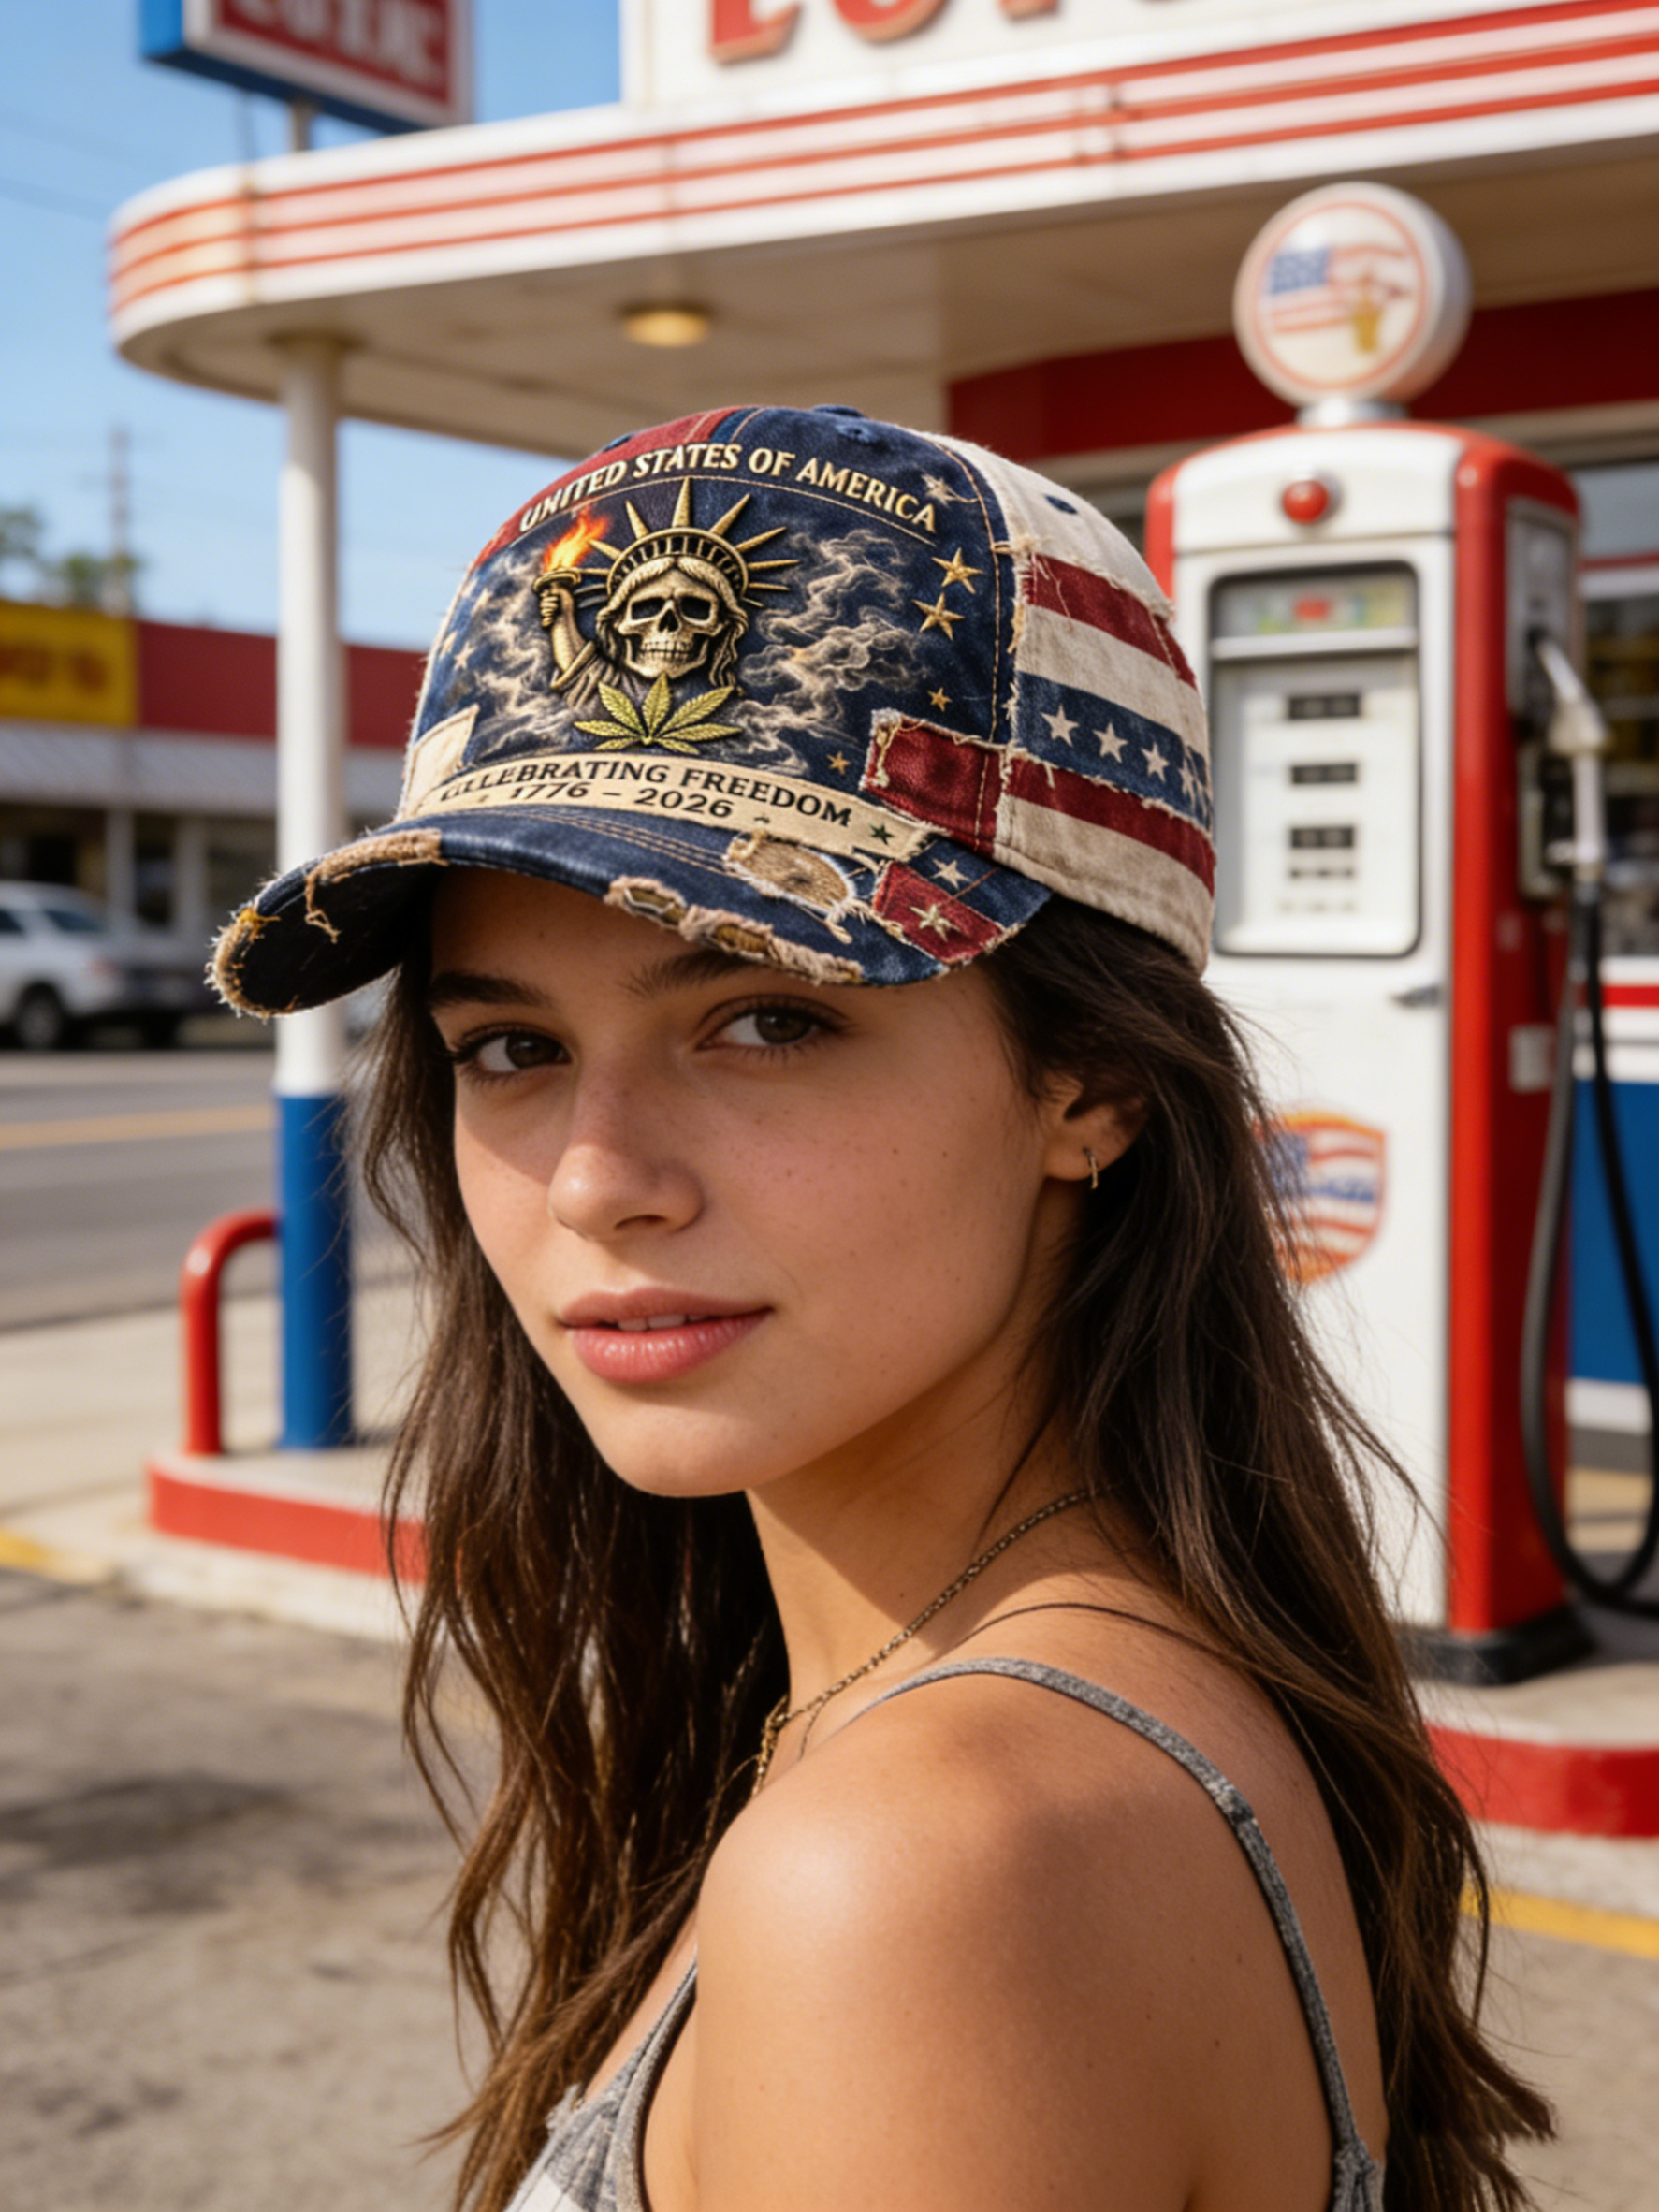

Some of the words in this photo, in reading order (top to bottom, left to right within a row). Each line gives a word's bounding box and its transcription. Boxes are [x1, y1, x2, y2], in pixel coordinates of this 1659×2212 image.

[519, 459, 628, 532] UNITED
[633, 443, 742, 479] STATES
[748, 447, 795, 476] OF
[795, 457, 936, 532] AMERICA
[510, 781, 592, 799] 1776
[633, 787, 734, 819] 2026
[680, 768, 852, 828] FREEDOM
